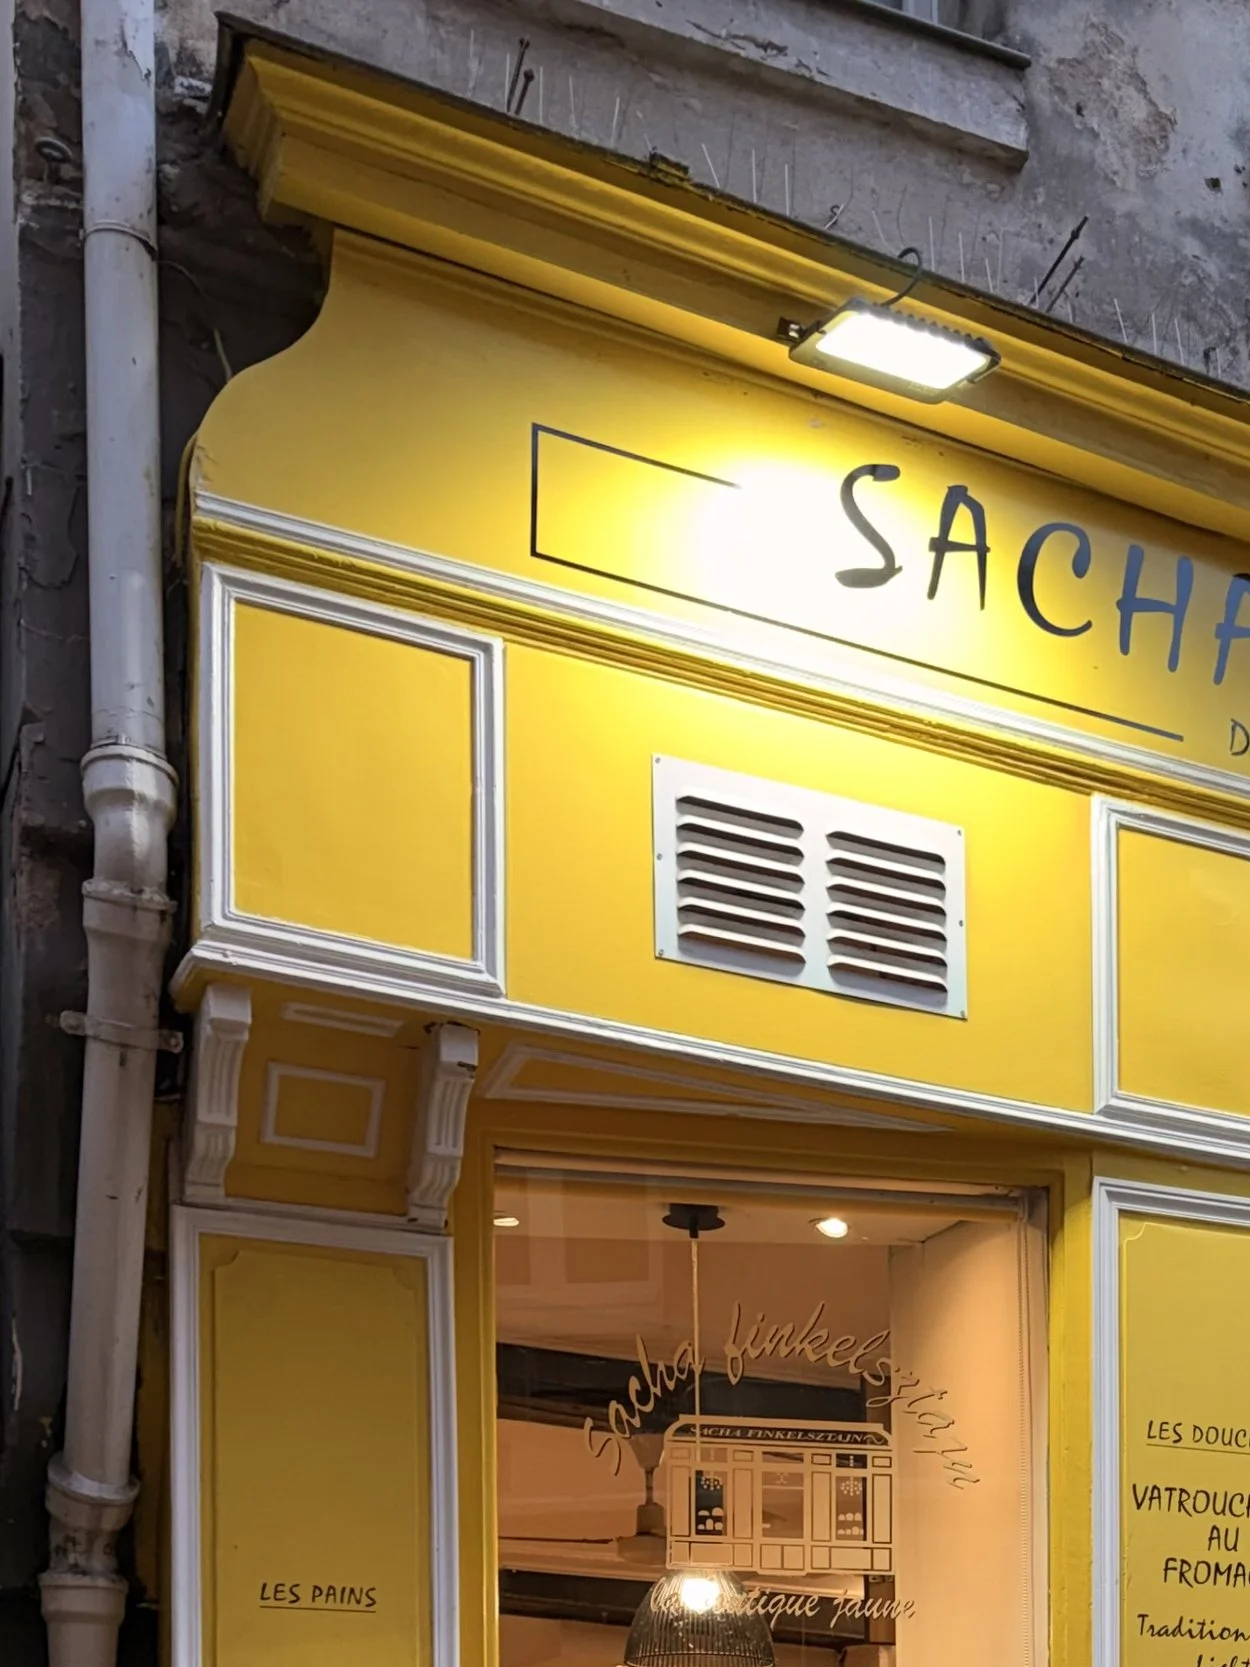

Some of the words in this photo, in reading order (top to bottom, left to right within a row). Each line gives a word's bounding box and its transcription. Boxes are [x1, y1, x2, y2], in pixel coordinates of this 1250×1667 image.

[1147, 1419, 1184, 1444] LES
[1207, 1524, 1240, 1552] AU
[259, 1581, 302, 1604] LES
[311, 1584, 378, 1609] PAINS
